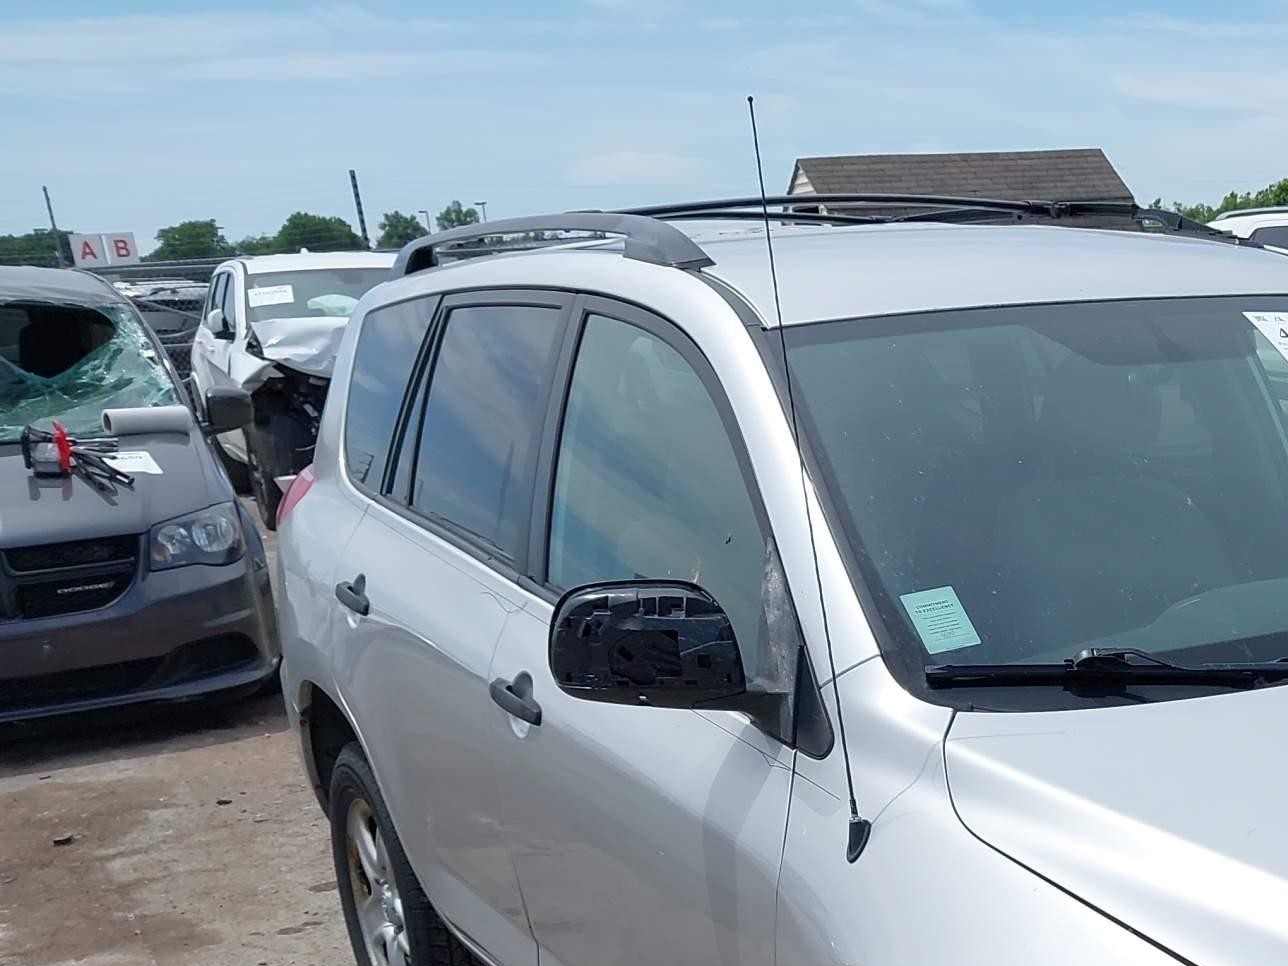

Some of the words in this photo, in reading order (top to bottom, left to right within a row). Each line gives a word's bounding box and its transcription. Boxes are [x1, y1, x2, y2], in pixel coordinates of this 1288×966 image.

[81, 240, 98, 260] A
[113, 239, 131, 258] B
[56, 583, 106, 595] DODGE
